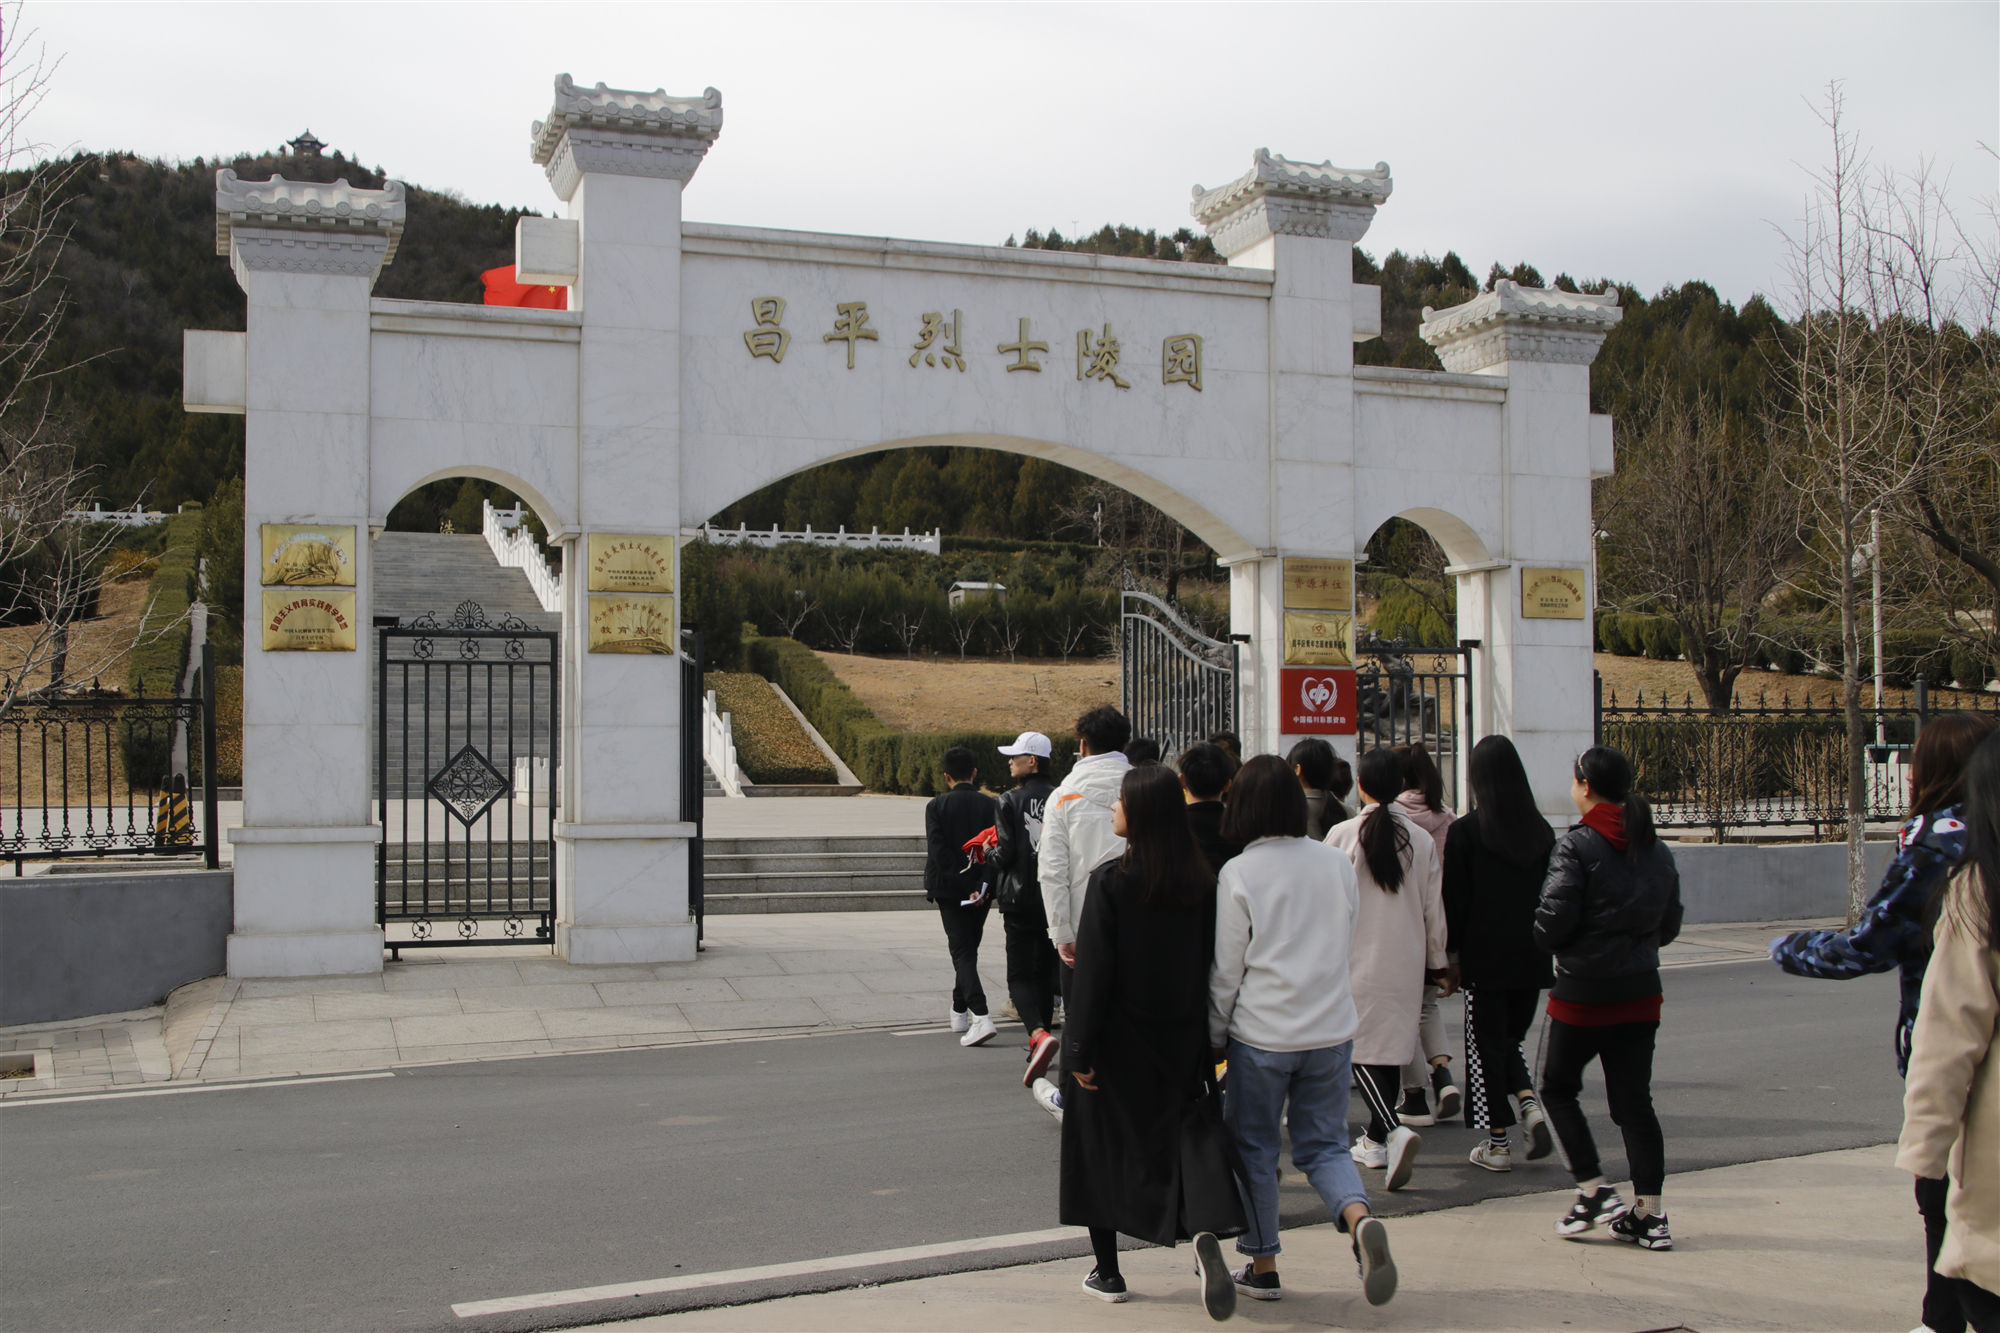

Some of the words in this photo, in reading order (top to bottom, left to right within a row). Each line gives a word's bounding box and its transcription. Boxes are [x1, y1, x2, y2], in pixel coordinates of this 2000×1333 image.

[744, 296, 1204, 392] 昌平烈士陵园
[594, 540, 668, 574] 昌平区爱国主义教育基地
[1294, 576, 1342, 590] 资源单位
[269, 598, 349, 632] 爱国主义教育实践教学基地
[600, 626, 663, 636] 教育基地
[1293, 716, 1346, 724] 中国福利彩票资助
